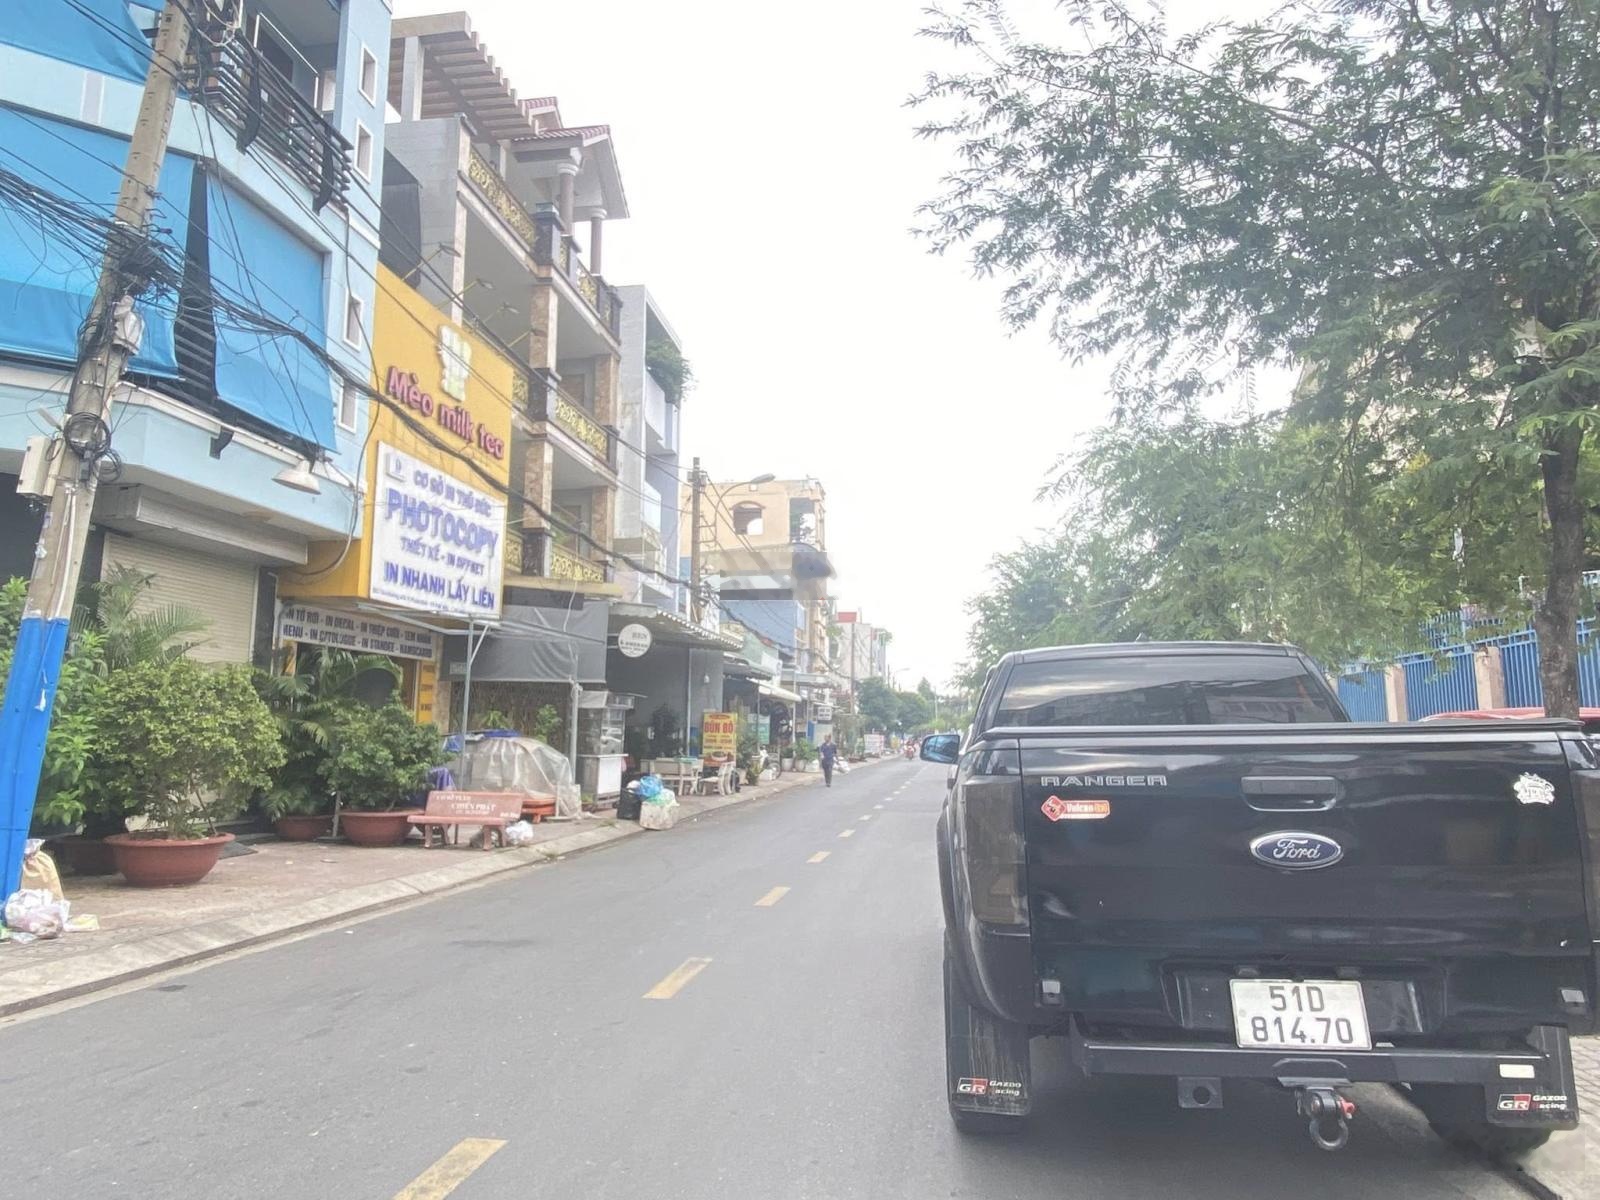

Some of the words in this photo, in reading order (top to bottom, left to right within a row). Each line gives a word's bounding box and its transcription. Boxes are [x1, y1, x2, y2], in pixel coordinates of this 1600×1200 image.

[386, 366, 434, 417] Mèo
[438, 404, 474, 443] milk
[478, 423, 504, 459] tea
[384, 487, 499, 559] PHOTOCOPY
[385, 562, 399, 585] IN
[401, 567, 446, 596] NHANH
[448, 576, 471, 603] LẤY
[704, 719, 721, 734] BÚN
[1040, 774, 1168, 788] RANGER
[1272, 837, 1321, 860] Ford
[1268, 985, 1325, 1013] 51D
[1251, 1015, 1354, 1045] 814.70
[959, 1083, 986, 1094] GR
[990, 1088, 1020, 1097] acing
[1499, 1100, 1528, 1109] GR
